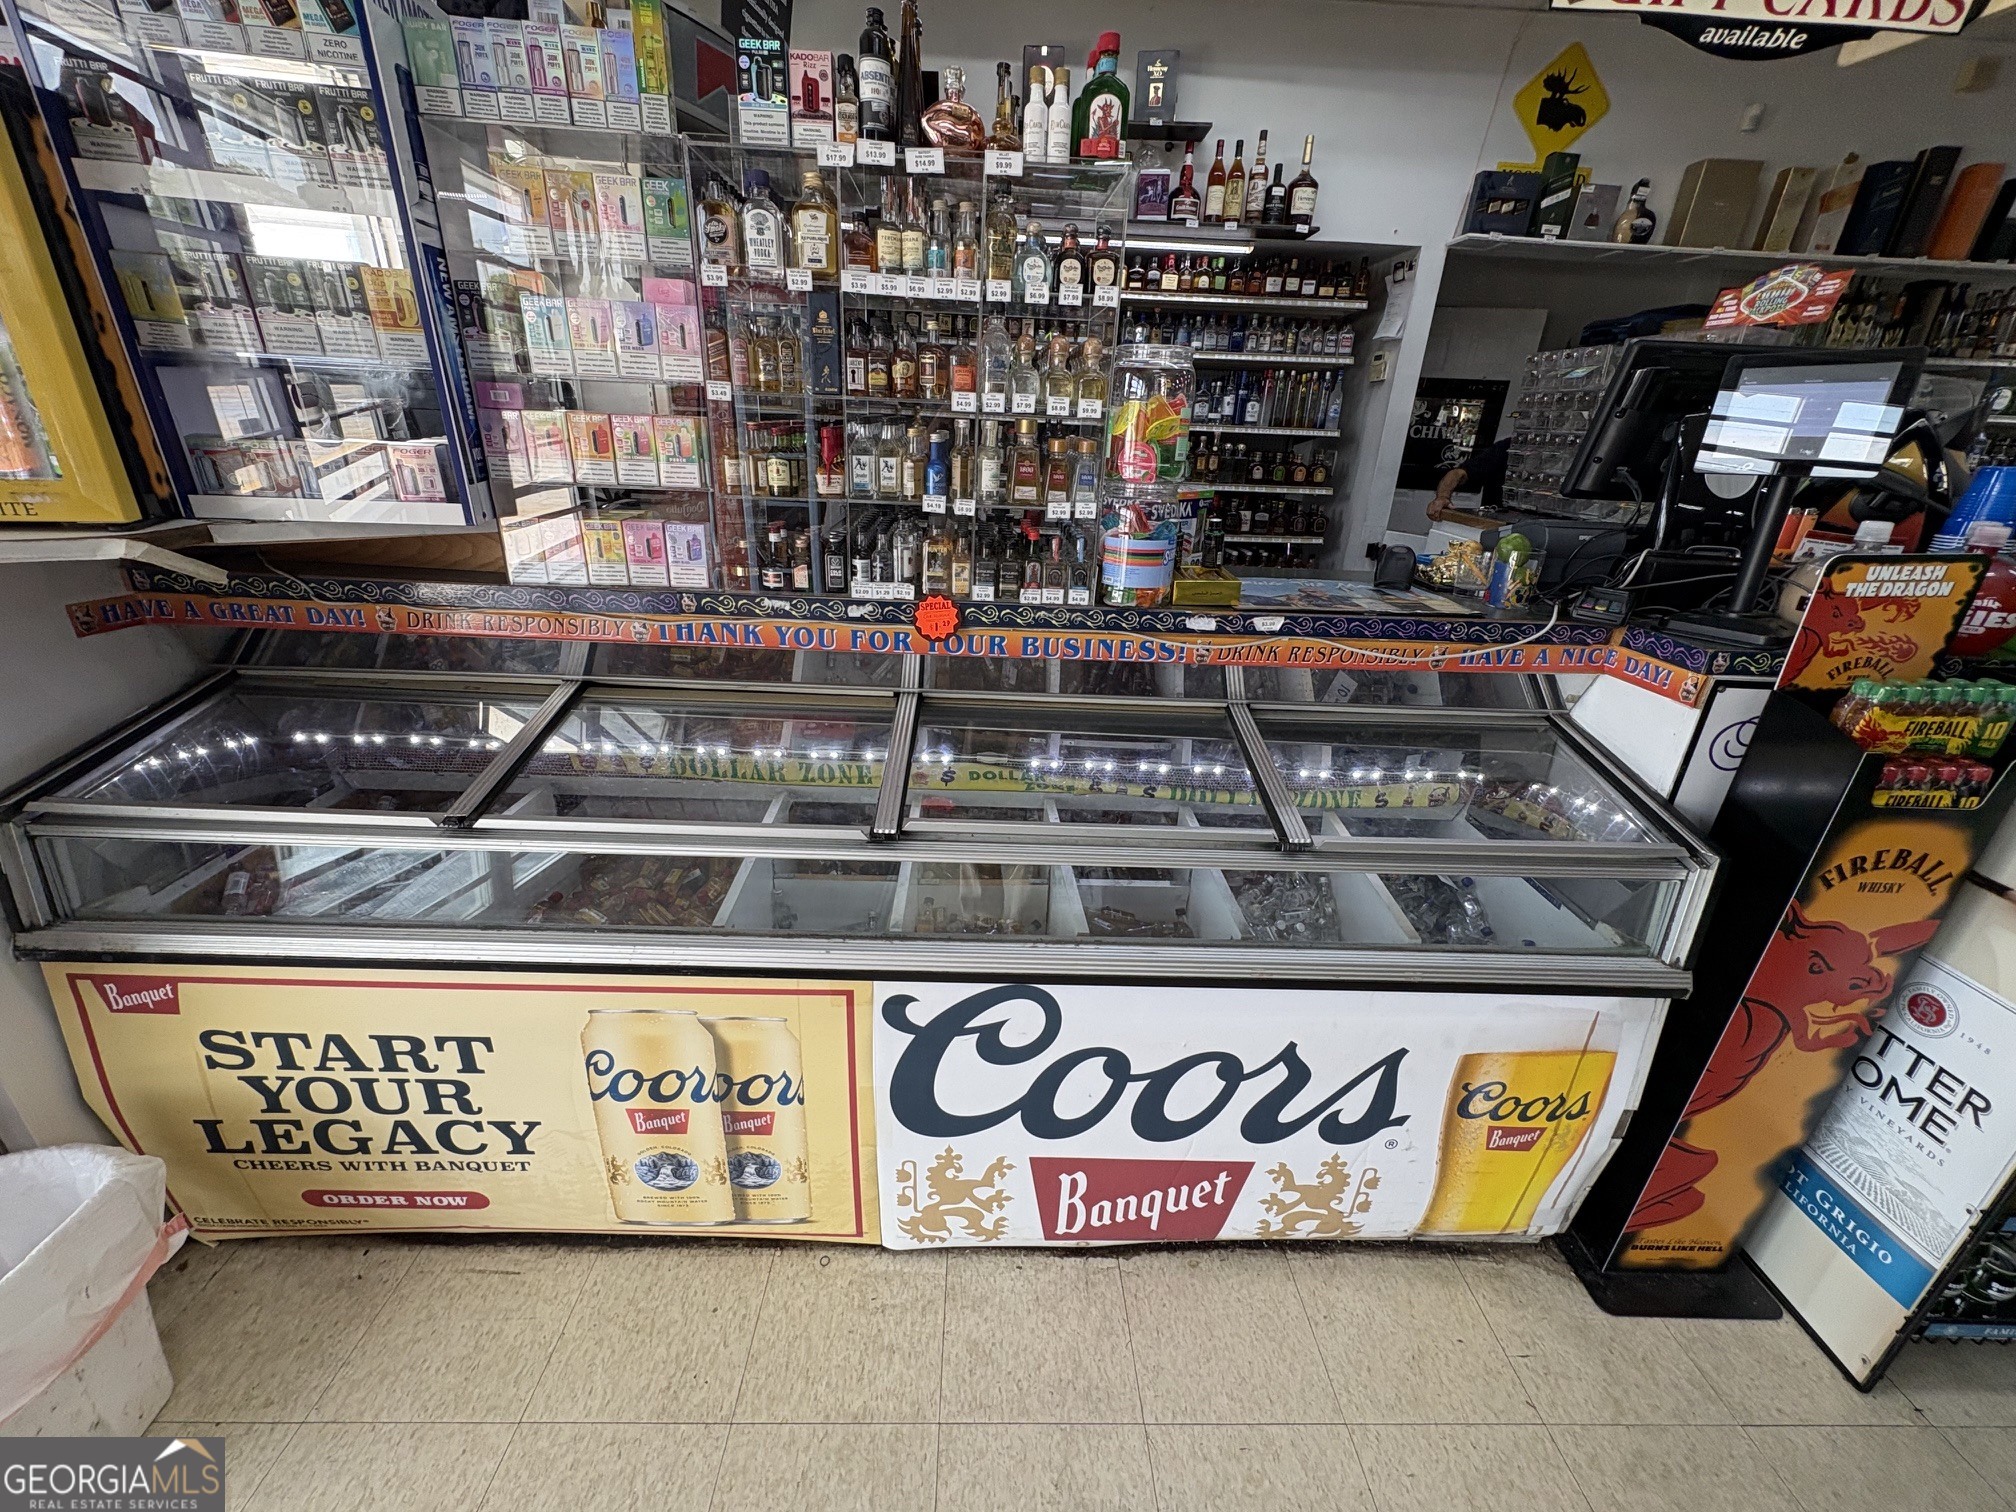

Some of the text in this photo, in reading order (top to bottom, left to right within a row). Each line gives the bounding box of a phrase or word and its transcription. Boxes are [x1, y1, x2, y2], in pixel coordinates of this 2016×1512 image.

[452, 20, 484, 29] FOGER
[487, 22, 519, 31] FOGER
[525, 24, 557, 34] FOGER
[1700, 26, 1808, 49] available
[323, 38, 347, 49] ZERO
[739, 38, 781, 50] GEEK BAR
[317, 49, 358, 61] NICOTINE
[790, 52, 829, 62] KADOBAR
[54, 57, 109, 71] FRUTTI BAR
[803, 61, 817, 69] Rizz
[189, 73, 222, 85] FRUTTI
[255, 80, 306, 93] FRUTTI BAR
[319, 86, 369, 99] FRUTTI BAR
[826, 154, 846, 162] $17.99
[866, 151, 886, 160] $13.99
[915, 159, 935, 168] $14.99
[995, 161, 1012, 170] $9.99
[596, 176, 636, 187] GEEK BAR
[644, 181, 668, 191] GEEK
[245, 256, 294, 267] FRUTTI BAR
[437, 257, 452, 301] NEW
[707, 274, 723, 282] $3.99
[791, 279, 808, 287] $2.99
[458, 281, 498, 292] GEEK BAR
[851, 282, 867, 290] $3.99
[937, 287, 953, 295] $2.99
[960, 288, 977, 296] $2.99
[991, 290, 1007, 298] $2.99
[1029, 292, 1046, 300] $6.99
[522, 297, 563, 308] GEEK BAR
[1063, 294, 1079, 302] $7.99
[711, 389, 727, 397] $3.49
[1016, 402, 1032, 410] $7.99
[1051, 405, 1067, 413] $8.99
[502, 411, 518, 420] BAR
[1082, 408, 1098, 416] $9.99
[570, 414, 590, 423] GEEK
[612, 414, 632, 423] GEEK
[392, 447, 432, 457] FOGER
[926, 502, 942, 510] $4.19
[1052, 509, 1067, 517] $2.99
[1078, 509, 1093, 517] $2.99
[667, 524, 686, 533] GEEK
[1866, 565, 1949, 582] UNLEASH
[1845, 582, 1955, 598] THE DRAGON
[976, 592, 991, 600] $2.99
[920, 602, 951, 611] SPECIAL
[101, 600, 368, 628] HAVE A GREAT DAY!
[406, 611, 627, 637] DRINK RESPONSIBLY
[657, 623, 1188, 663] THANK YOU FOR YOUR BUSINESS!
[1217, 645, 1427, 666] DRINK RESPONSIBLY
[1459, 648, 1675, 689] HAVE A NICE DAY!
[1826, 656, 1895, 682] FIREBALL
[1904, 721, 2009, 739] FIREBALL 10
[669, 755, 874, 785] DOLLAR ZONE
[1818, 849, 1953, 896] FIREBALL
[1857, 881, 1905, 893] WHISKY
[103, 982, 174, 1011] Banquet
[1959, 1032, 1992, 1055] 1948
[198, 1029, 495, 1075] START
[882, 984, 1412, 1145] Coors
[237, 1074, 483, 1116] YOUR
[1457, 1081, 1592, 1123] Coors
[634, 1111, 686, 1132] Banquet
[723, 1114, 772, 1134] Banquet
[194, 1118, 542, 1156] LEGACY
[1859, 1096, 1946, 1167] VINEYARDS
[1489, 1130, 1541, 1149] Banquet
[233, 1158, 532, 1174] CHEERS WITH BANQUET
[323, 1192, 468, 1207] ORDER NOW
[1055, 1170, 1232, 1236] Banquet
[193, 1216, 268, 1226] CELEBRATE
[1815, 1189, 1894, 1265] GRIGIO
[1638, 1237, 1665, 1246] Tastes
[1667, 1237, 1687, 1245] Like
[1630, 1244, 1670, 1252] BURNS
[1671, 1244, 1696, 1252] LIKE
